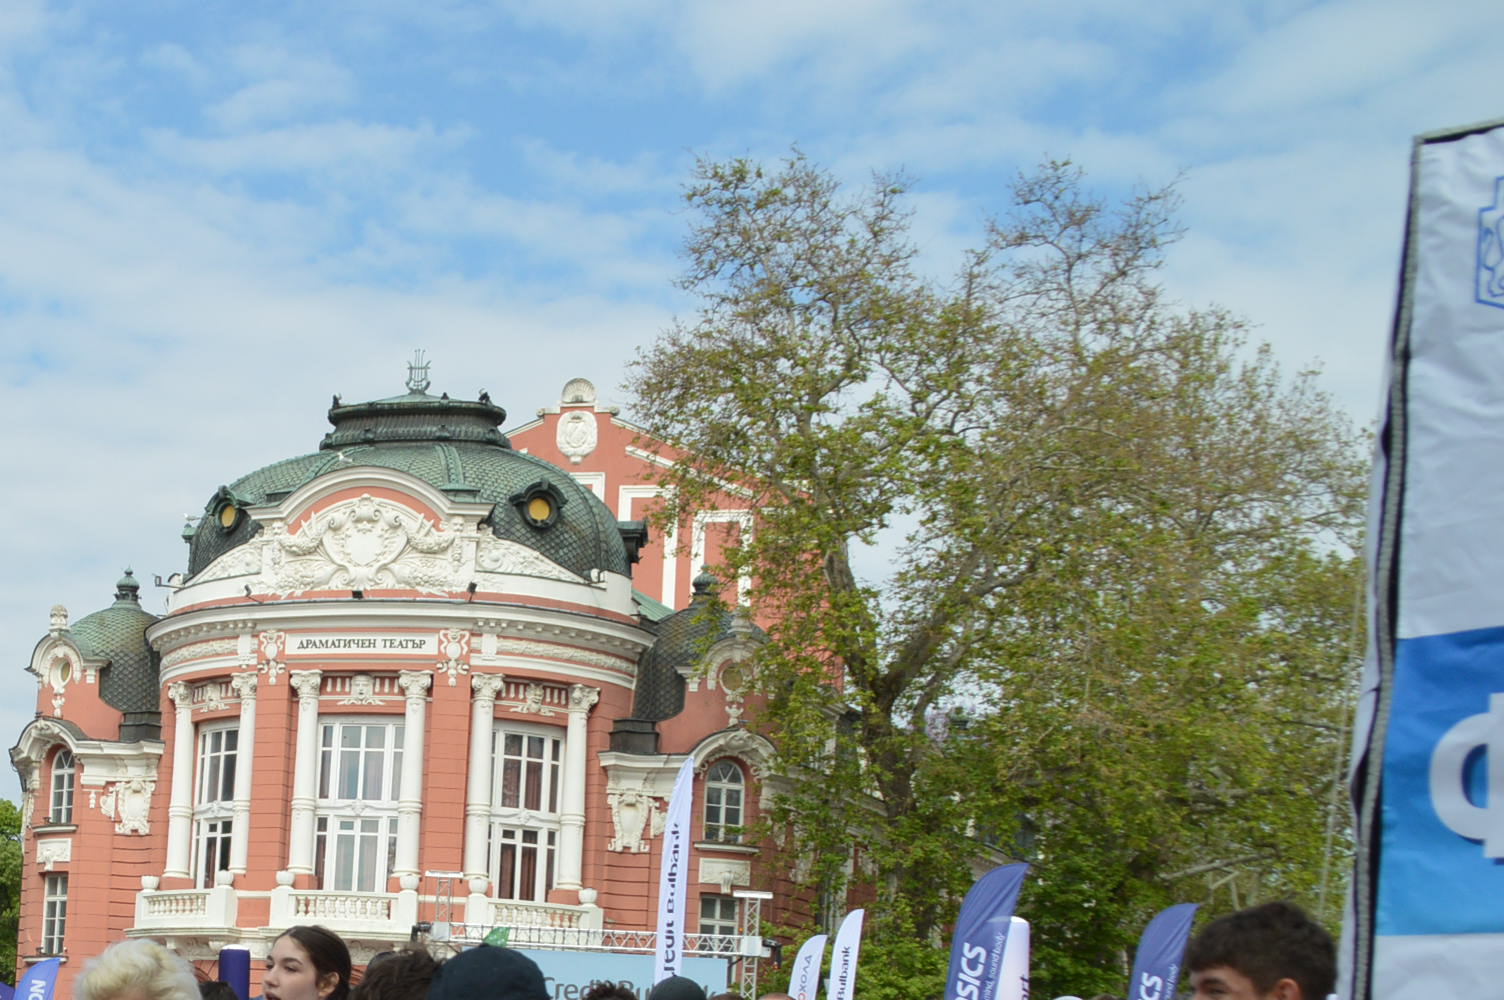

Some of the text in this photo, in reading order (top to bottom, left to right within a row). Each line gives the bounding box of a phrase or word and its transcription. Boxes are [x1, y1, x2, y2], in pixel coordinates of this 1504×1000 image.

[297, 638, 426, 651] ДРАМАТИЧЕН ТЕАТЪР
[836, 945, 852, 1000] Bulbank
